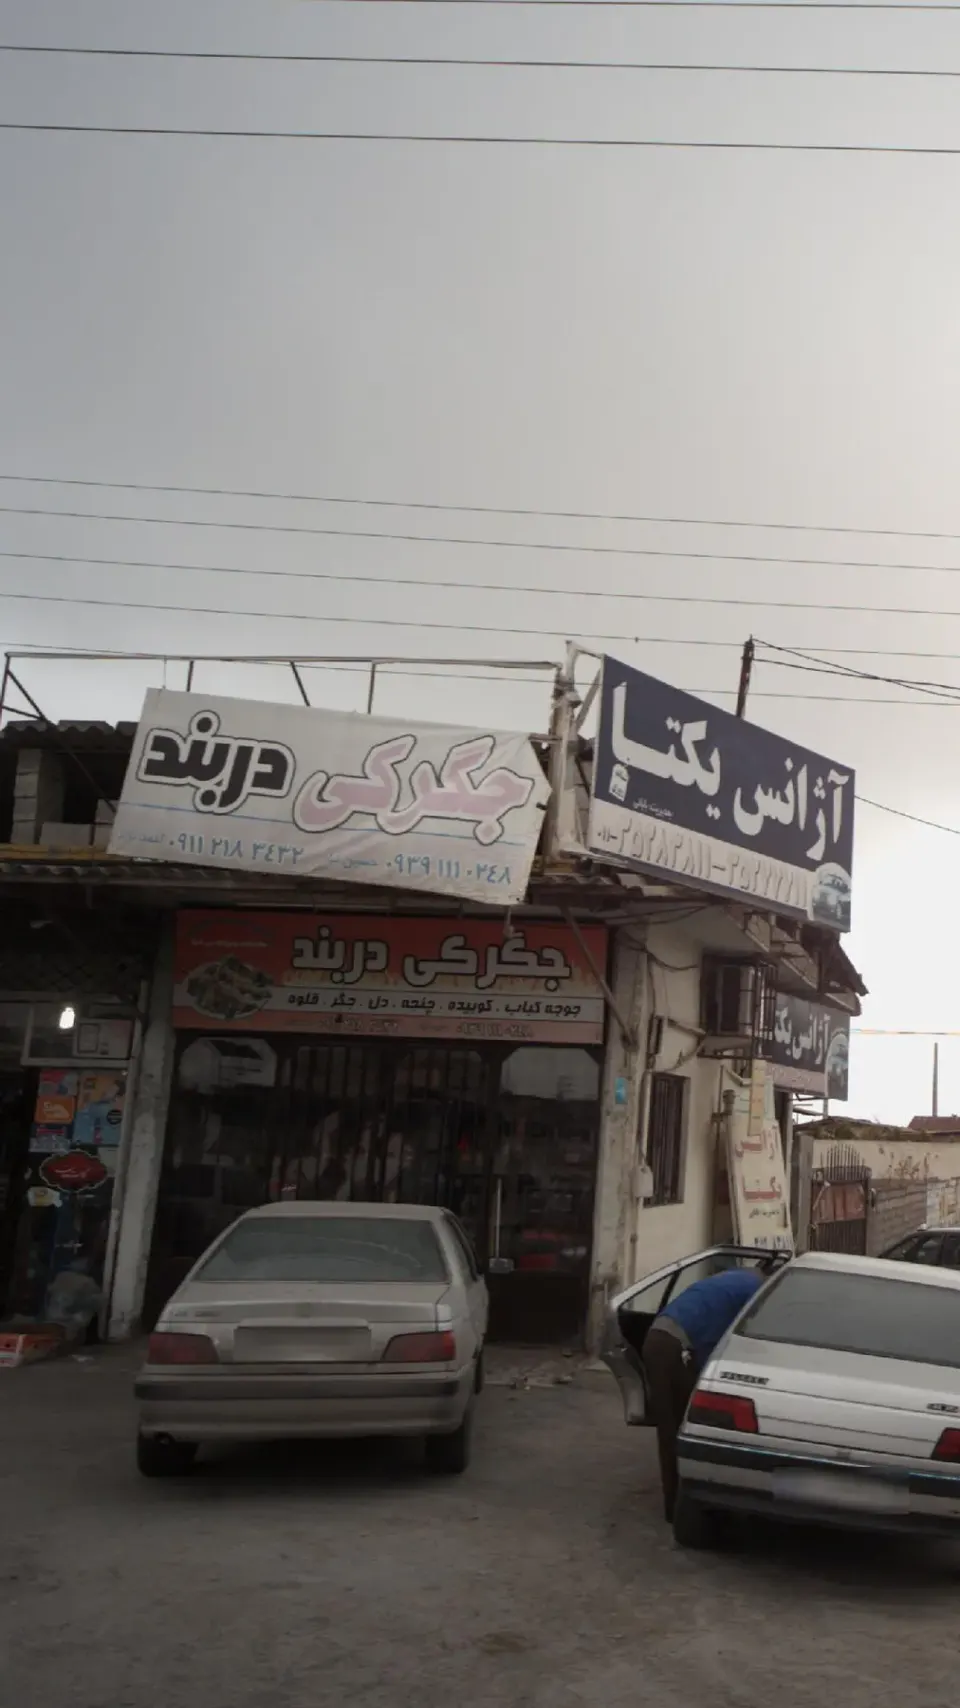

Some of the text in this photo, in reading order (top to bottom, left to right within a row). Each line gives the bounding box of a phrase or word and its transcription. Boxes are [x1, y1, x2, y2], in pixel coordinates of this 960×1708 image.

[135, 709, 296, 815] دربند
[611, 681, 849, 861] آژانس یکتا
[291, 925, 572, 992] جگرکی دربند
[367, 995, 389, 1010] دل
[447, 999, 494, 1015] کوبیده
[504, 1000, 542, 1017] کباب
